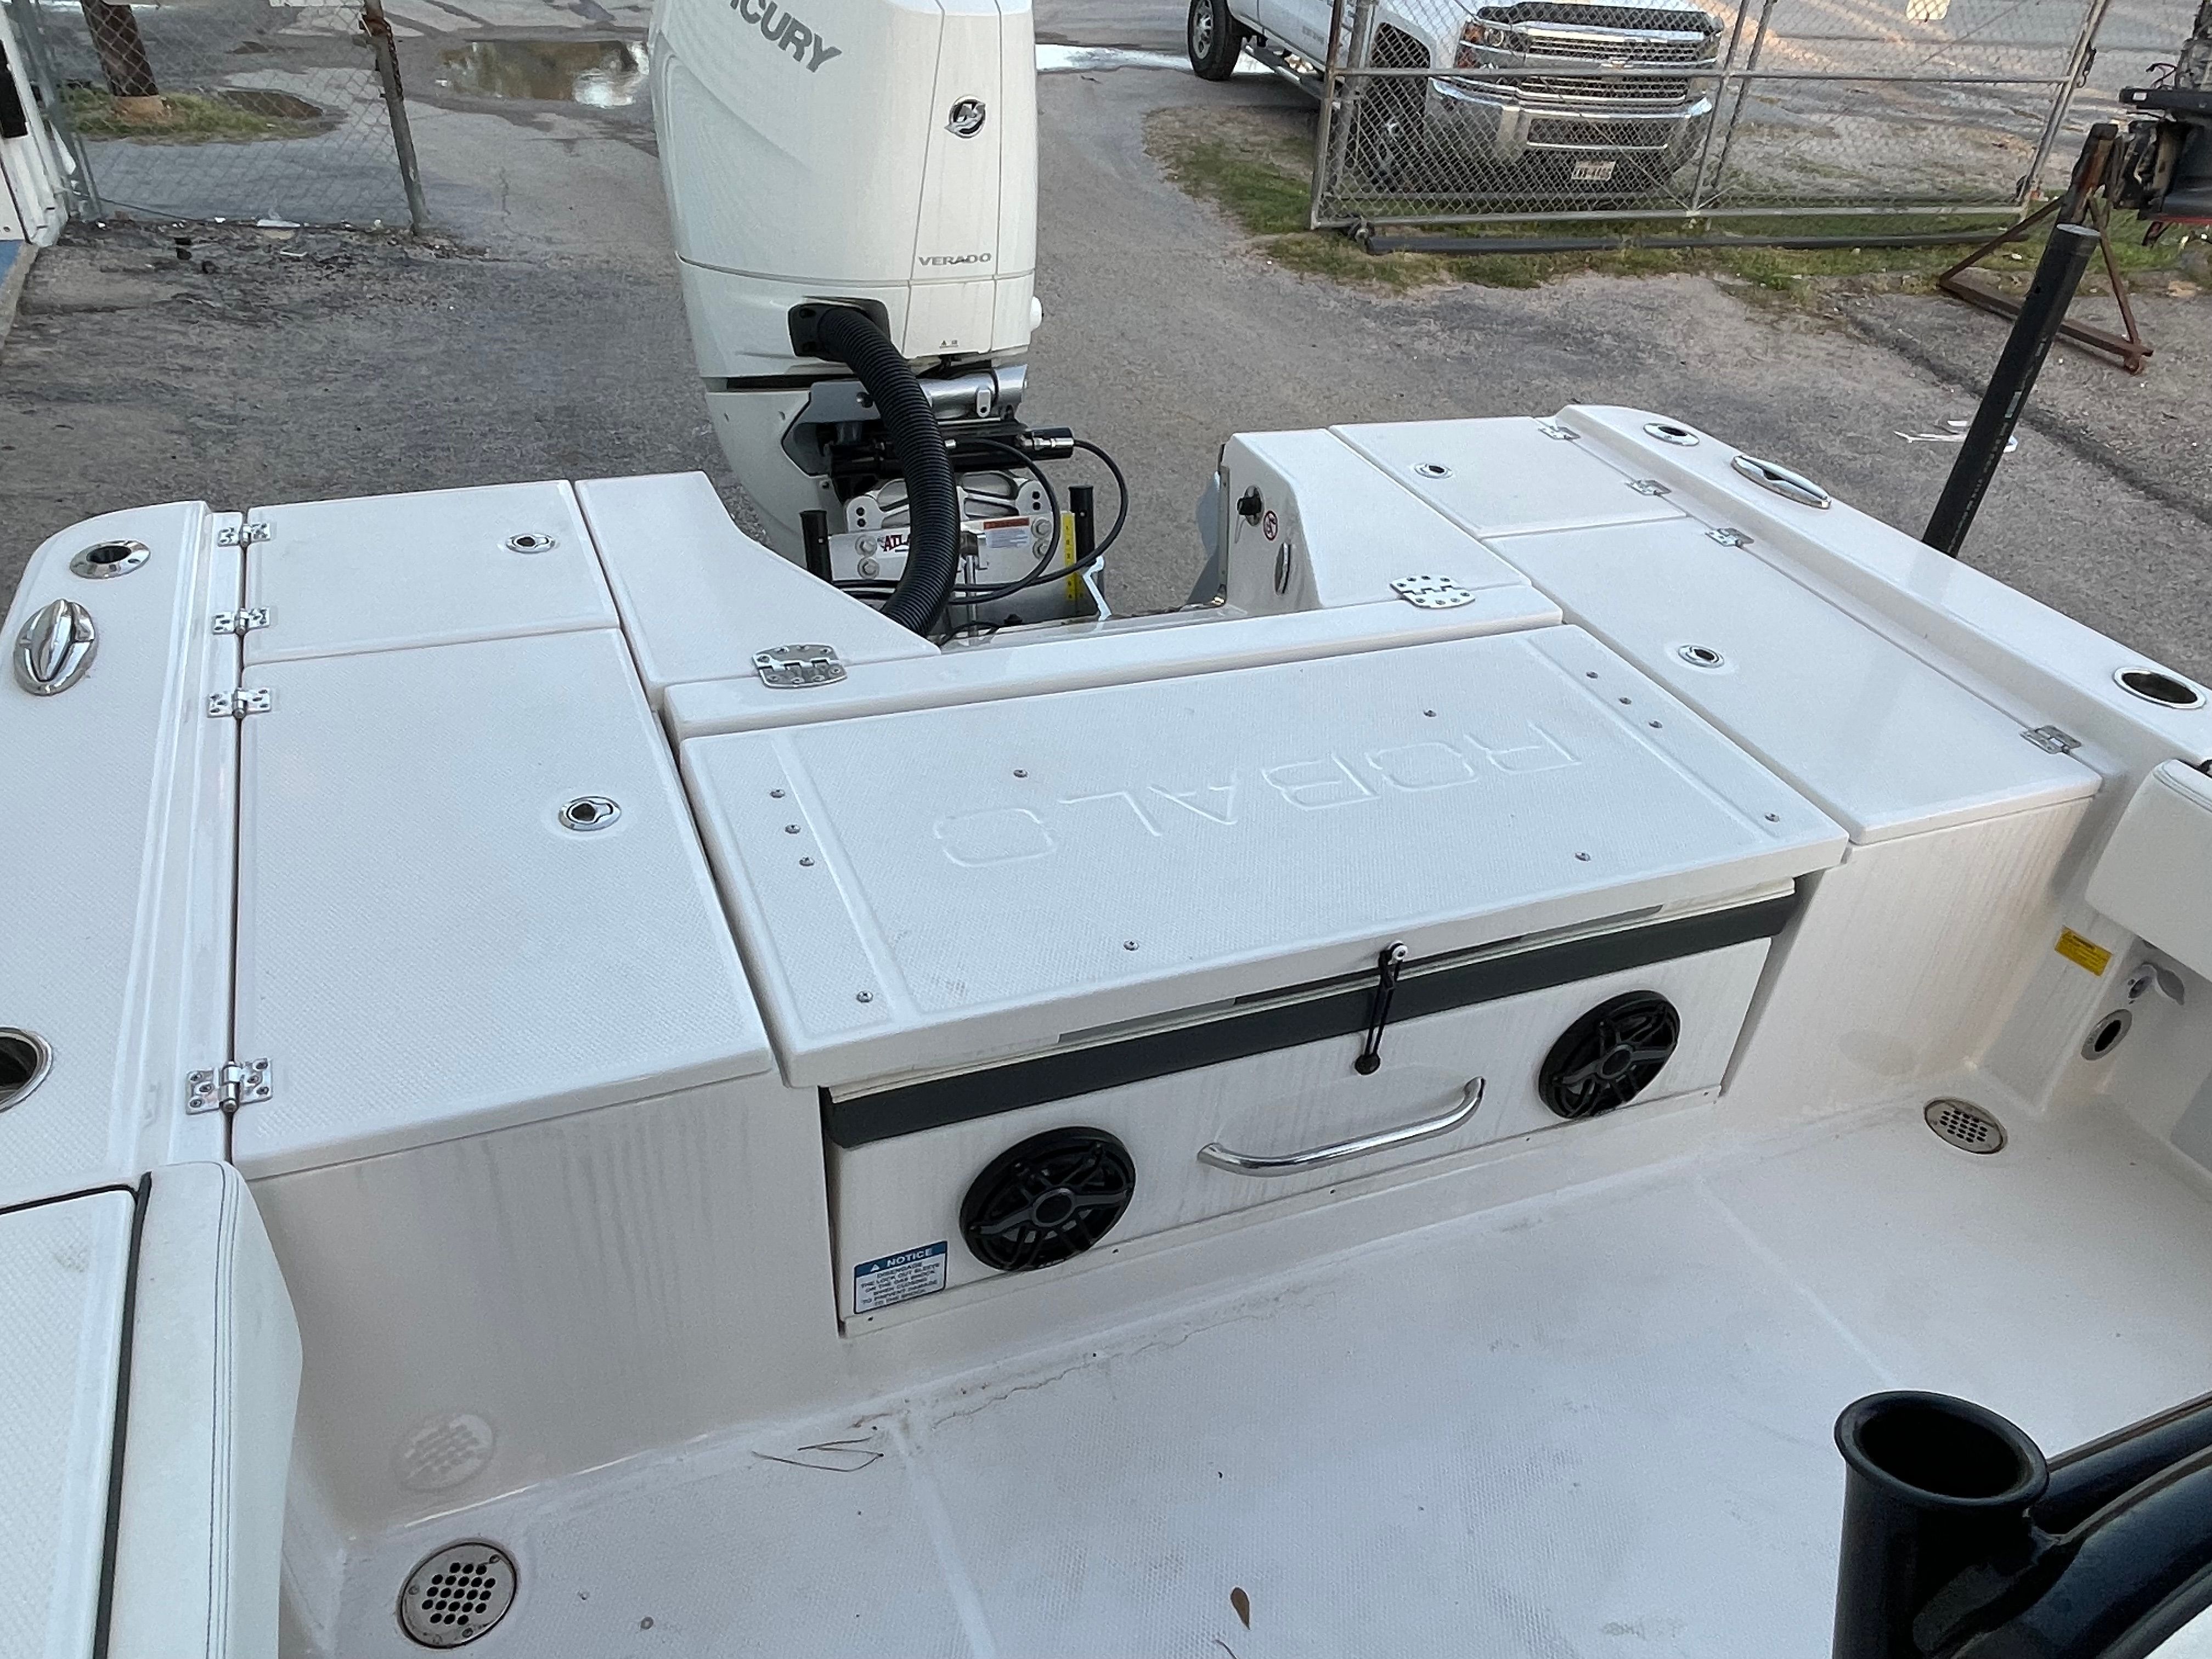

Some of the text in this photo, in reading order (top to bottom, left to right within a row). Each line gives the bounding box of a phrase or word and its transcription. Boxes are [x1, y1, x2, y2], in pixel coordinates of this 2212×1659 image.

[730, 0, 843, 72] CURY
[918, 252, 992, 266] VERADO
[932, 720, 1582, 867] ROBALO
[887, 1248, 933, 1267] NOTICE
